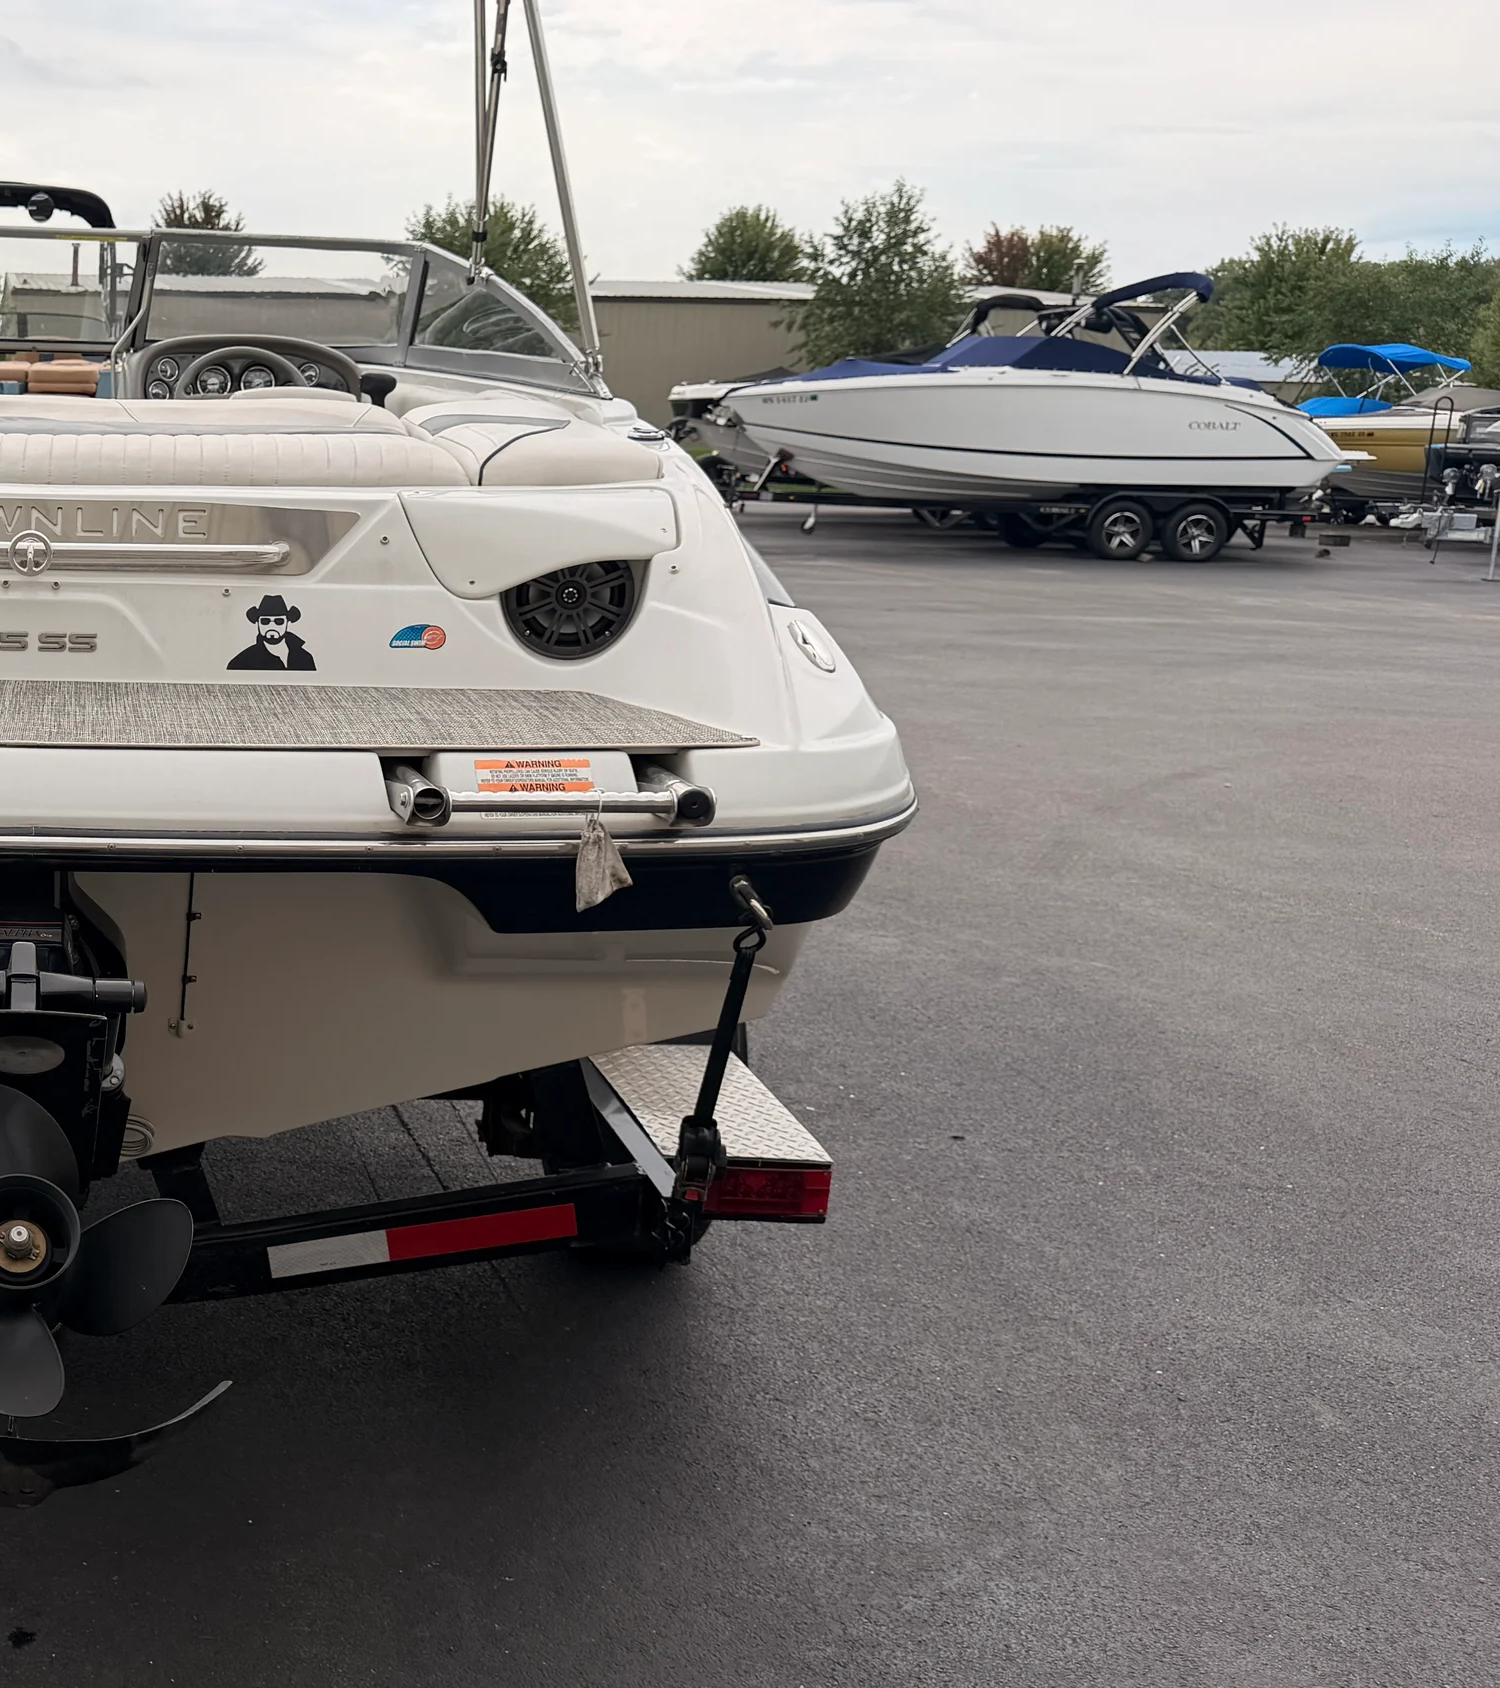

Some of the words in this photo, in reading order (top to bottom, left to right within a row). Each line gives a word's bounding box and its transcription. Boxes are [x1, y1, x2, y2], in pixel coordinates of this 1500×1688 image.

[1188, 421, 1241, 431] COBALT
[38, 632, 98, 652] SS
[516, 760, 562, 769] WARNING
[520, 783, 566, 792] WARNING
